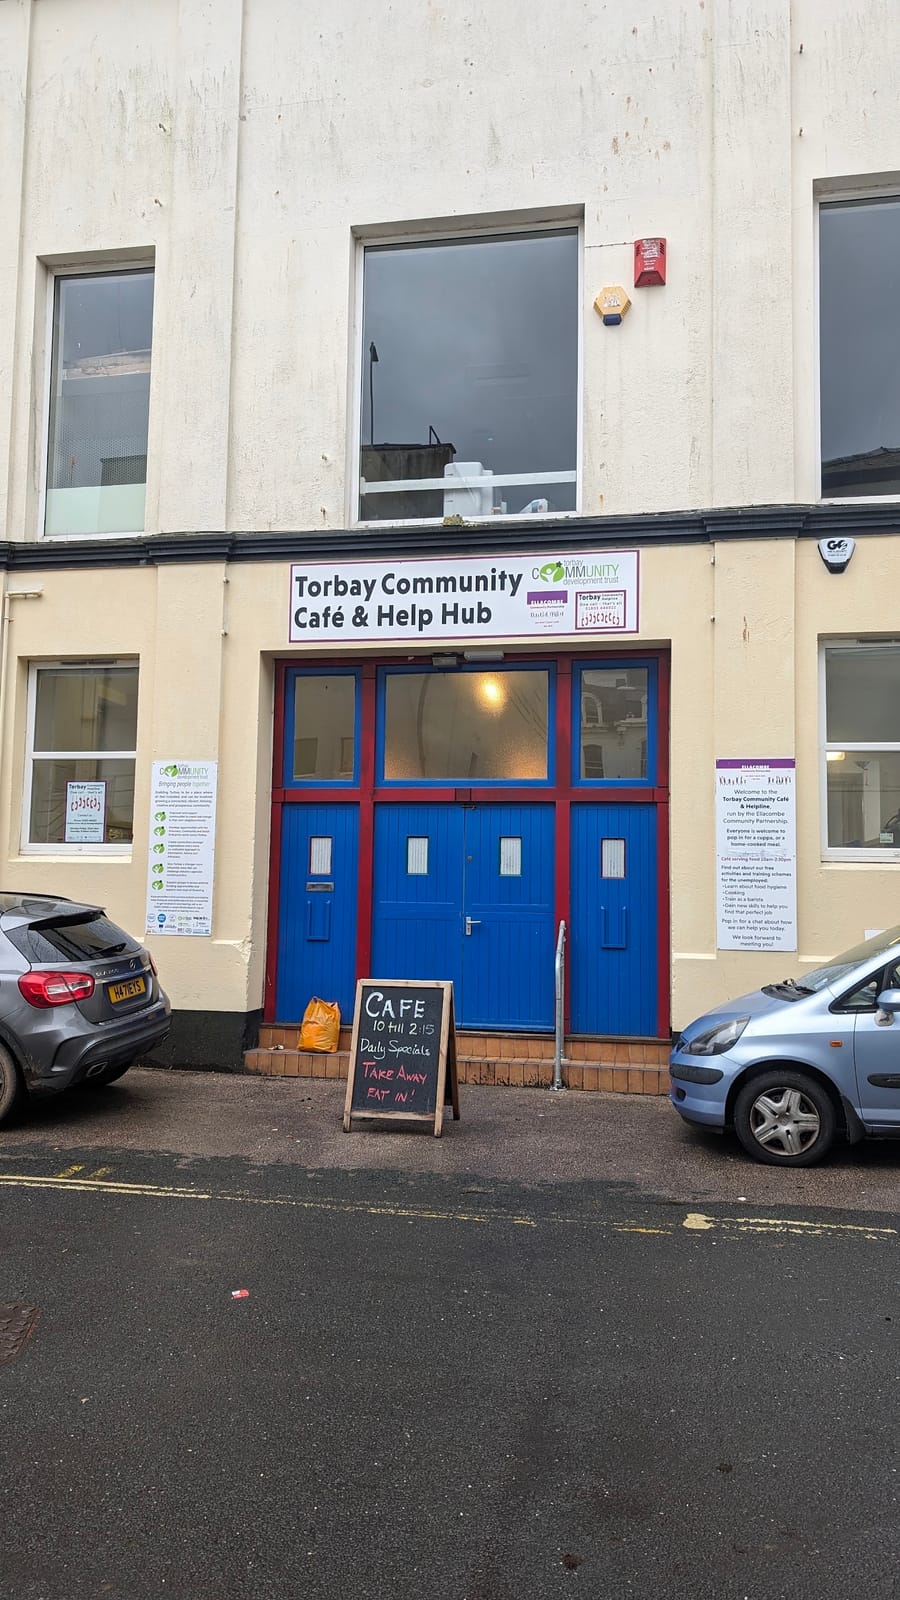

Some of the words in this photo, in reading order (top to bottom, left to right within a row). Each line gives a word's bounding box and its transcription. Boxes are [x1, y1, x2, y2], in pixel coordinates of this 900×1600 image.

[563, 559, 584, 567] torbay
[295, 575, 376, 601] Torbay
[381, 567, 523, 597] Community
[563, 577, 603, 586] development
[604, 576, 619, 584] trust
[294, 605, 345, 629] Café
[351, 605, 369, 627] &
[377, 604, 433, 631] Help
[441, 601, 492, 624] Hub
[365, 991, 426, 1019] CAFE
[373, 1020, 386, 1032] 10
[388, 1021, 404, 1034] till
[408, 1022, 435, 1035] 2:15
[360, 1038, 386, 1060] Daily
[388, 1039, 431, 1059] Specials
[366, 1087, 390, 1101] EAT
